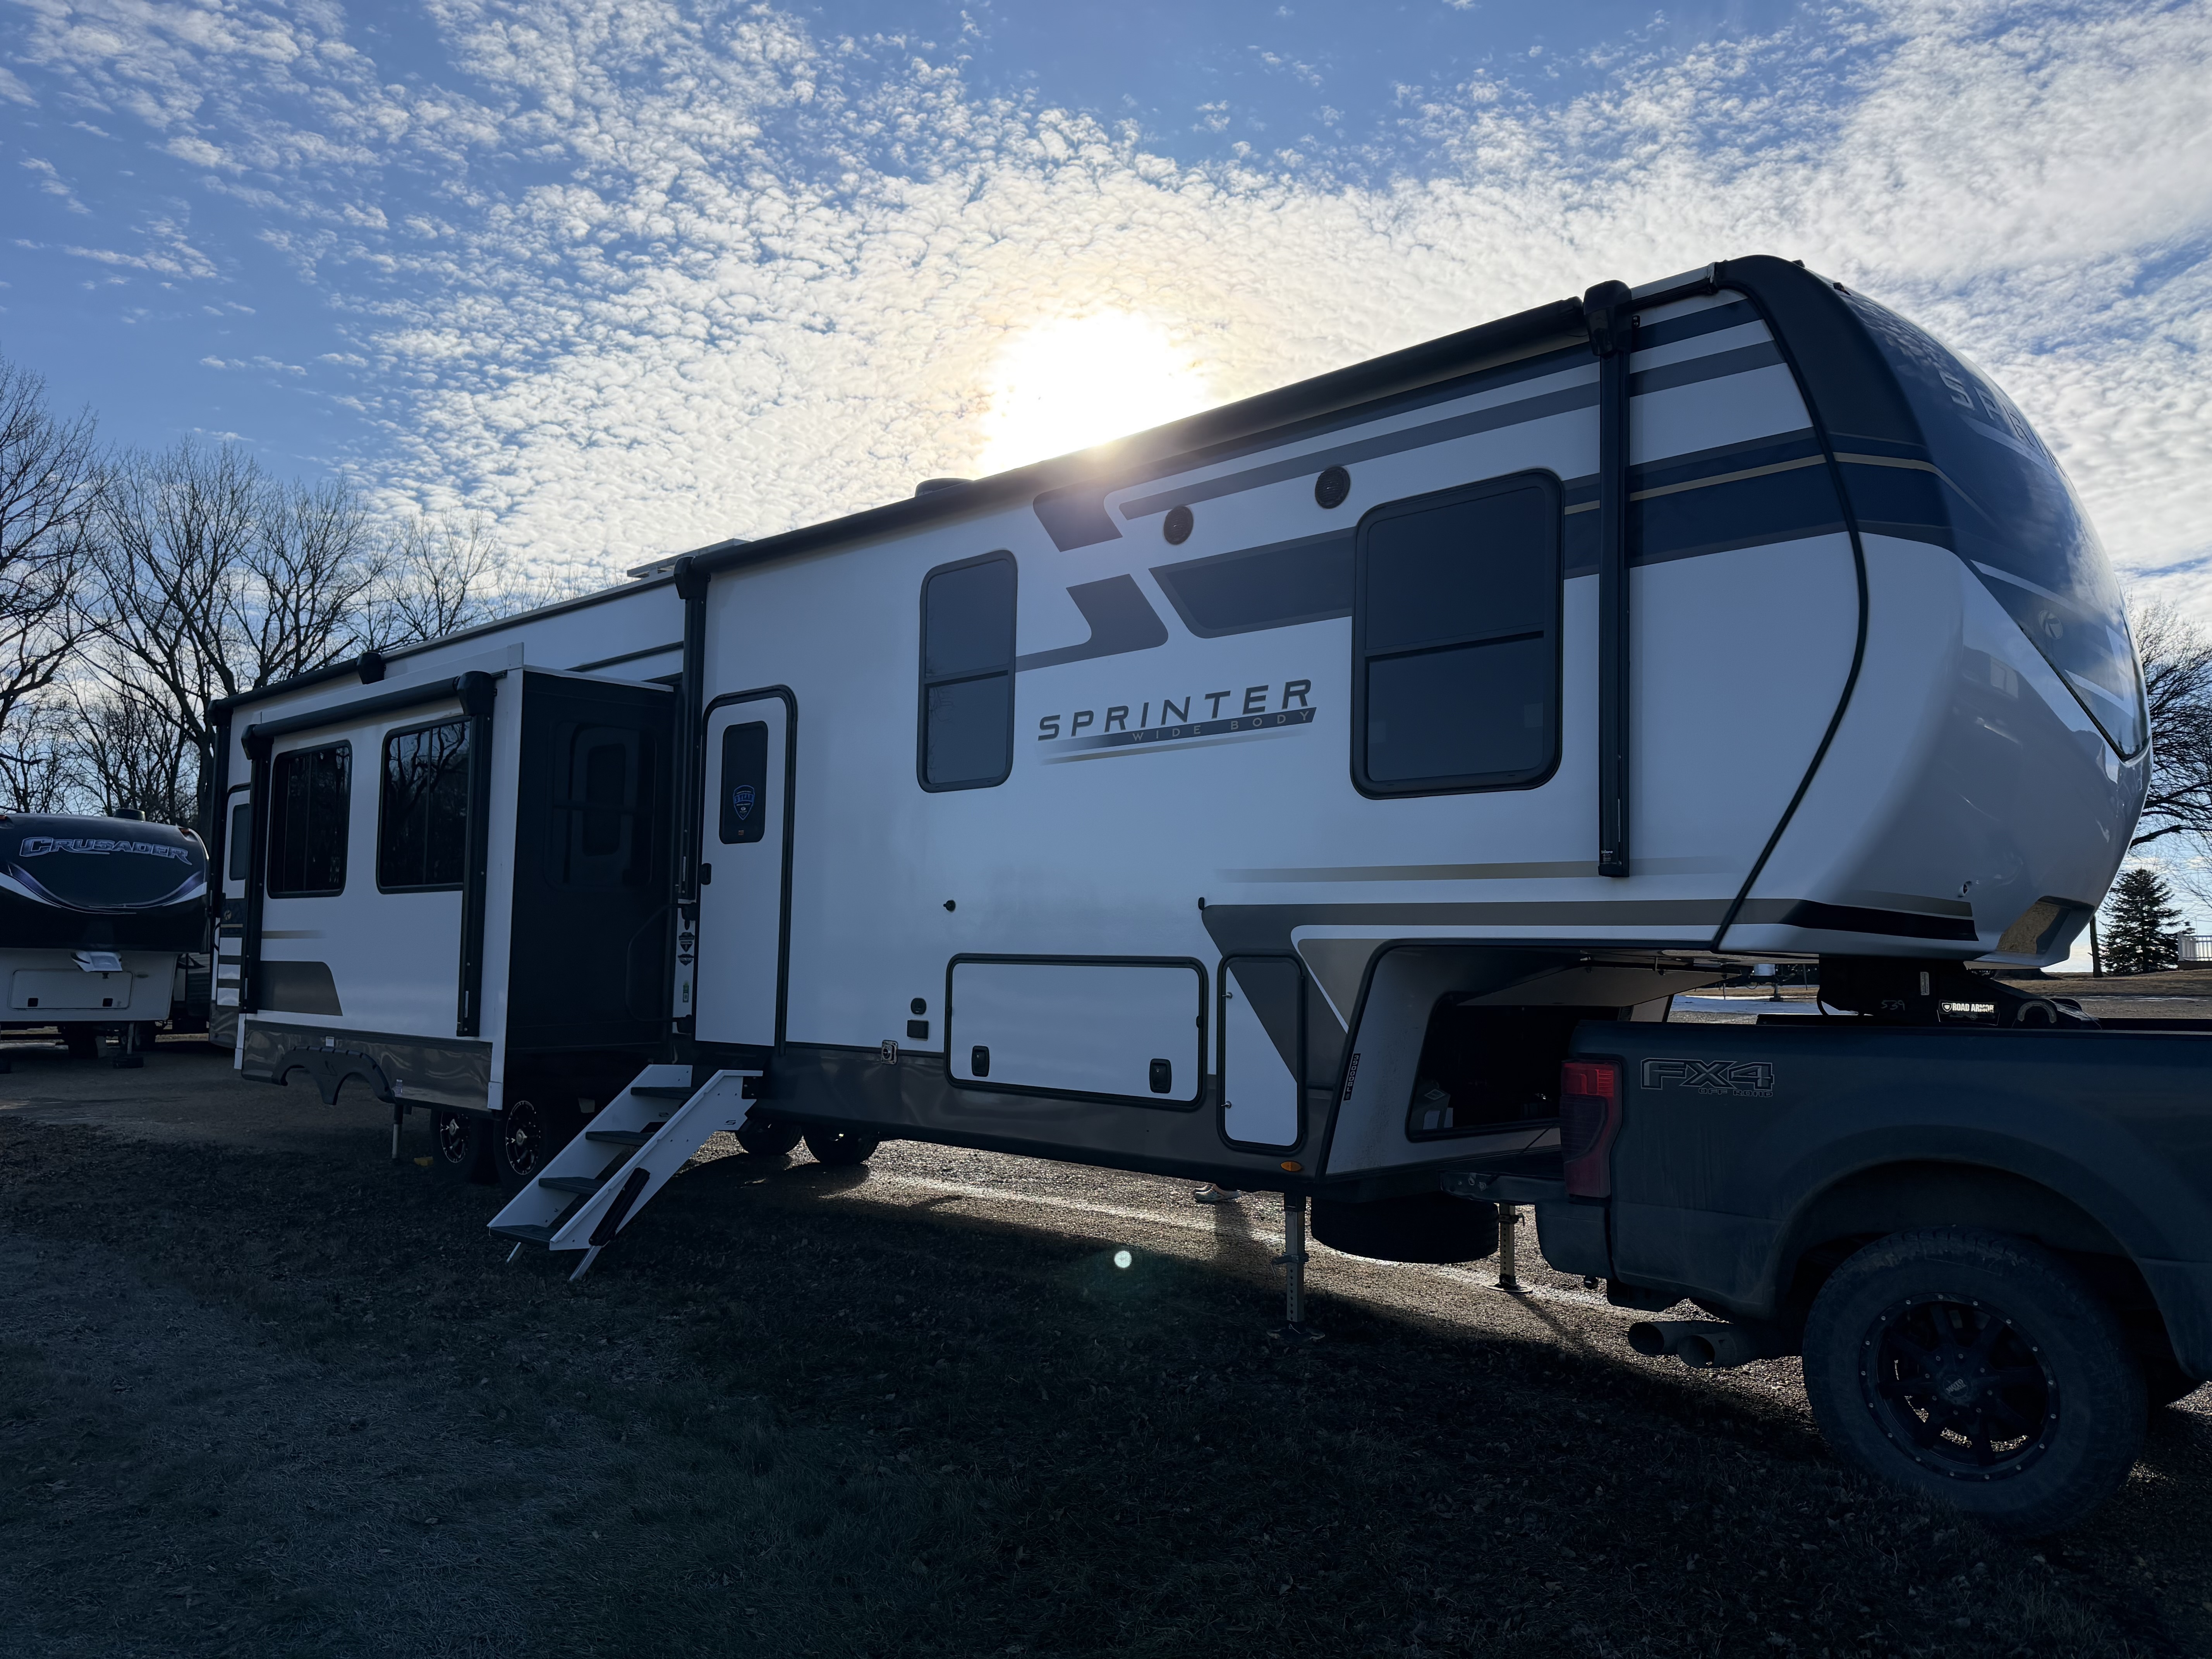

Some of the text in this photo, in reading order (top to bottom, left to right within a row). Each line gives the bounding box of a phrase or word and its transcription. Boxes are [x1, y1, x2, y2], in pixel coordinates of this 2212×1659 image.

[1038, 679, 1311, 741] SPRINTER
[1132, 711, 1309, 741] WIDE BODY
[19, 836, 192, 866] CRUSADER
[1880, 999, 1905, 1011] 539
[1952, 1003, 1995, 1013] ROAD ARMOR
[1641, 1058, 1774, 1091] FX4
[1733, 1089, 1773, 1097] ROAD
